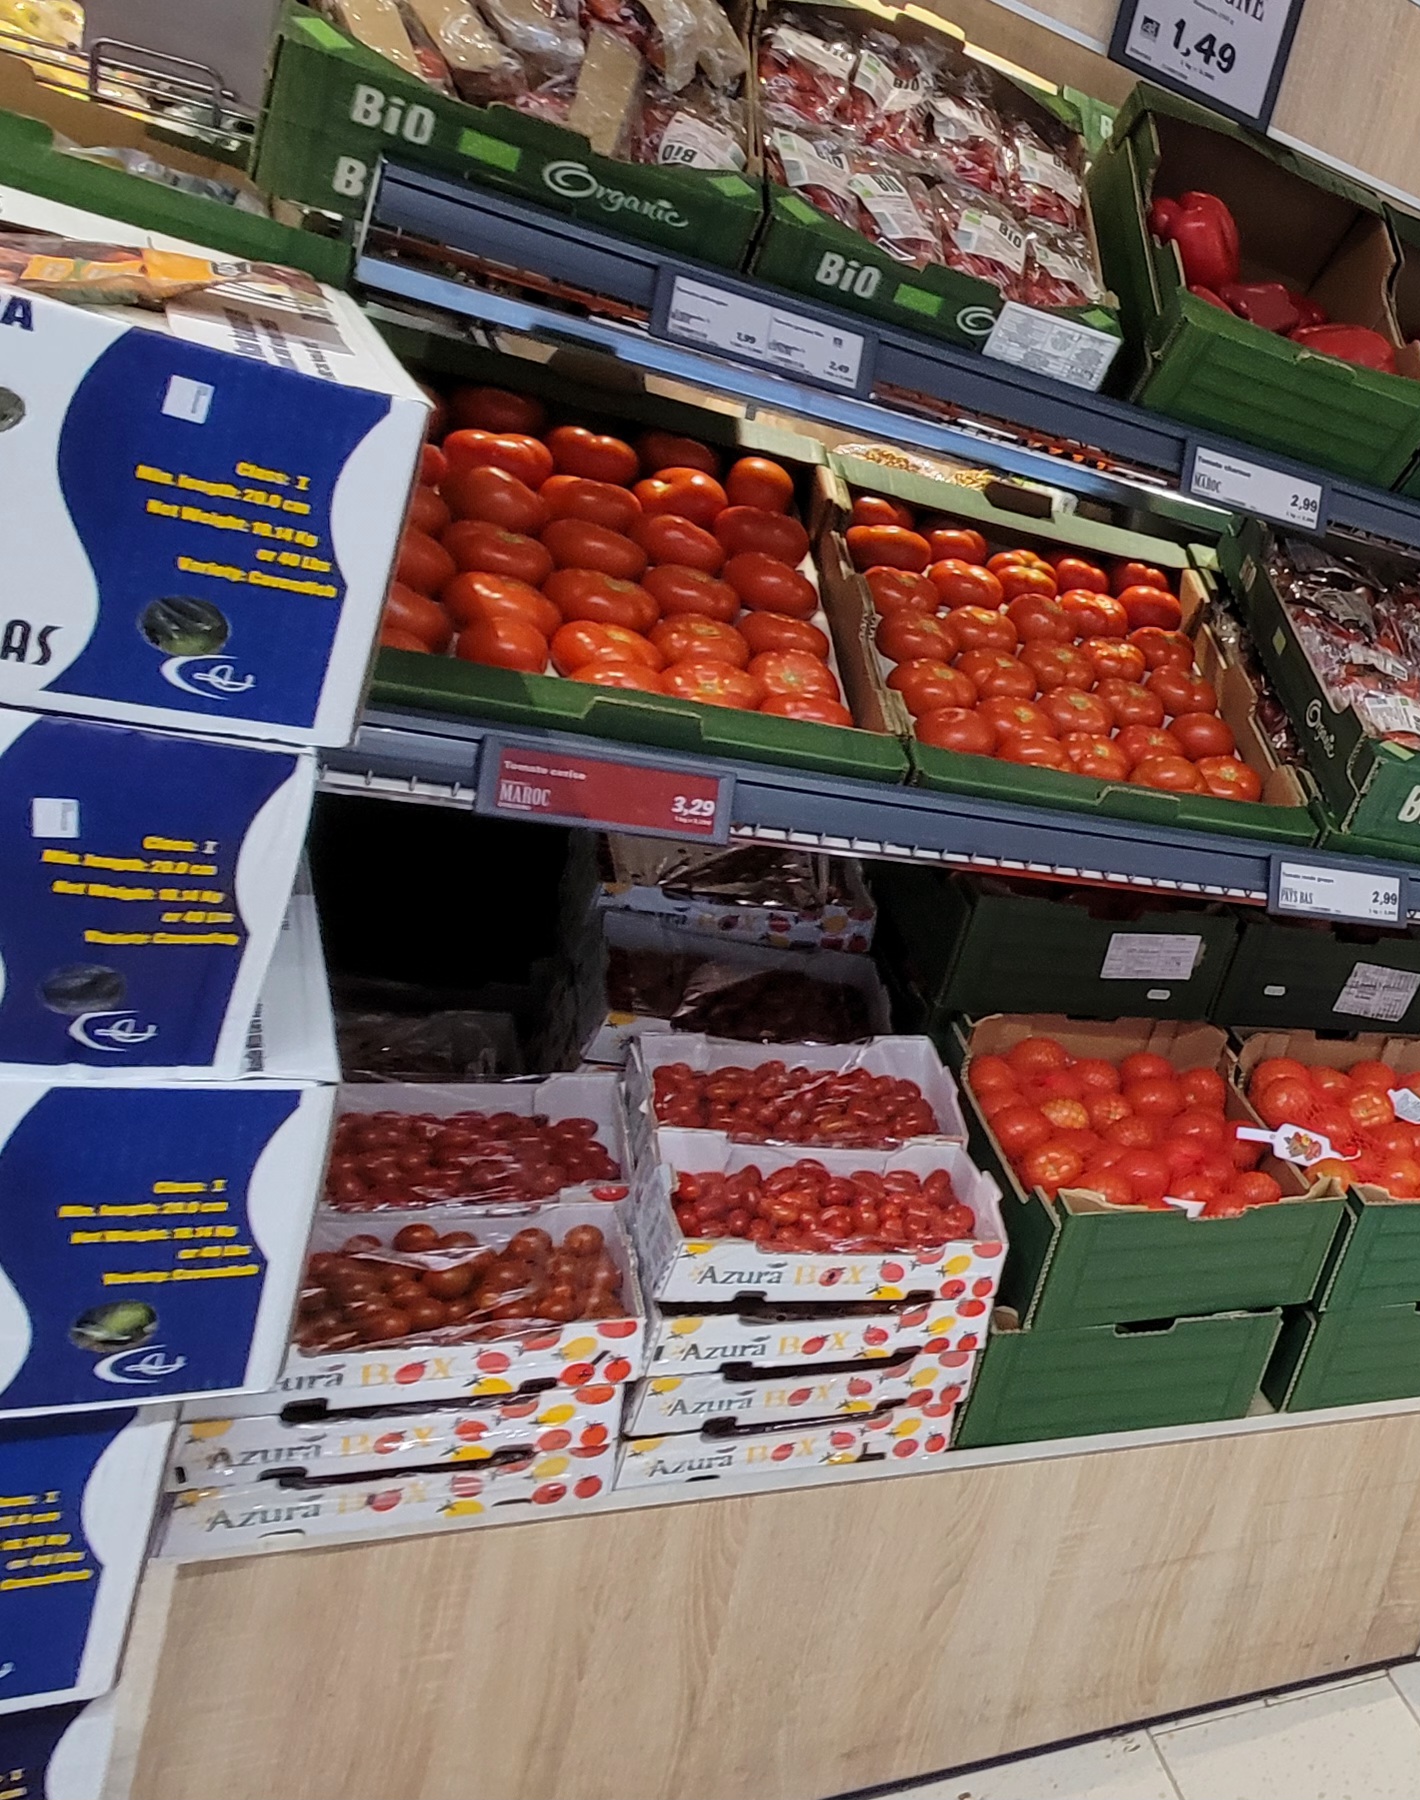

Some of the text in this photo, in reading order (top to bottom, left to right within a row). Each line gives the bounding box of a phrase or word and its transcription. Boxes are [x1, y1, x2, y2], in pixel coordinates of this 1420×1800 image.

[1173, 18, 1237, 74] 1,49
[542, 160, 689, 229] Organic
[1198, 455, 1223, 470] Tomate
[1290, 494, 1318, 513] 2,99
[504, 759, 548, 777] Tomate
[499, 782, 551, 808] MAROC
[671, 795, 716, 817] 3,29
[1371, 890, 1398, 906] 2,99
[697, 1264, 785, 1285] Azura
[681, 1340, 767, 1362] Azura
[277, 1369, 344, 1392] ura
[668, 1395, 753, 1417] Azura
[205, 1501, 321, 1532] Azura
